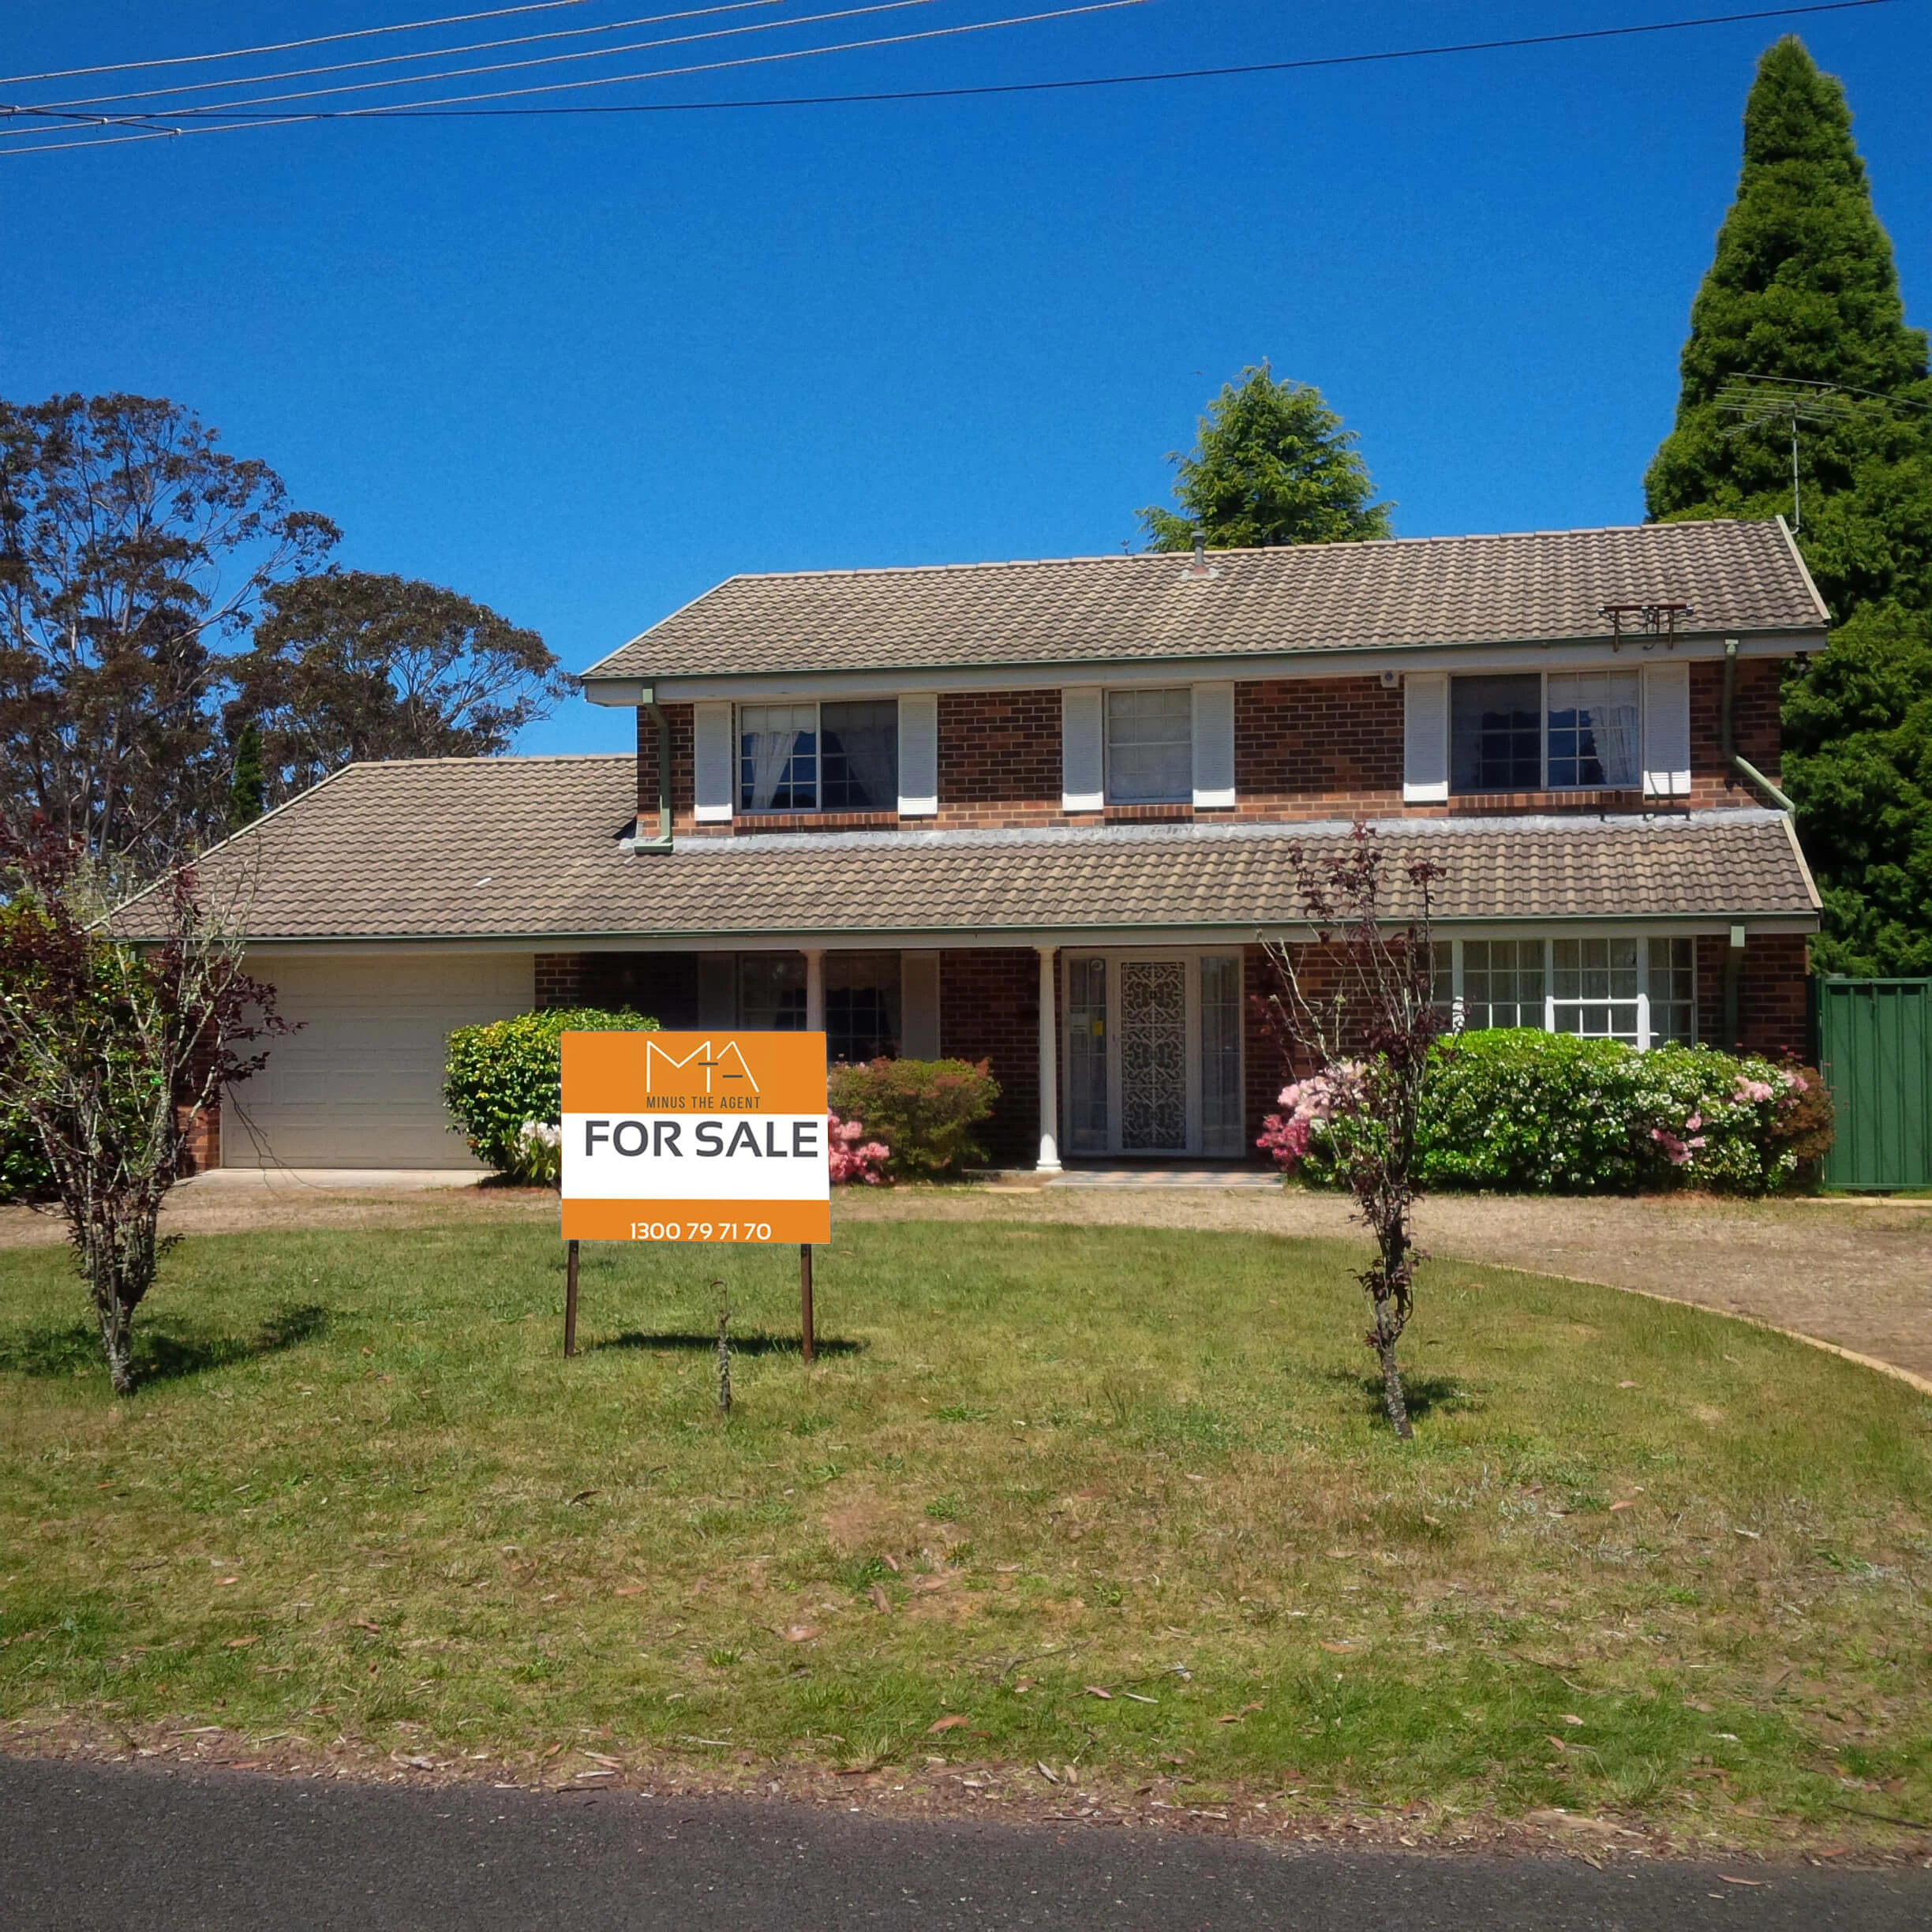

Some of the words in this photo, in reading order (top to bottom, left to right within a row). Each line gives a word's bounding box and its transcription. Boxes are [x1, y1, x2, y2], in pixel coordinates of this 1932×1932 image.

[646, 1096, 686, 1109] MINUS
[691, 1096, 714, 1109] THE
[721, 1096, 761, 1109] AGENT
[586, 1120, 683, 1157] FOR
[695, 1121, 818, 1158] SALE
[630, 1222, 681, 1240] 1300
[687, 1222, 713, 1240] 79
[718, 1223, 738, 1240] 71
[743, 1223, 772, 1240] 70
